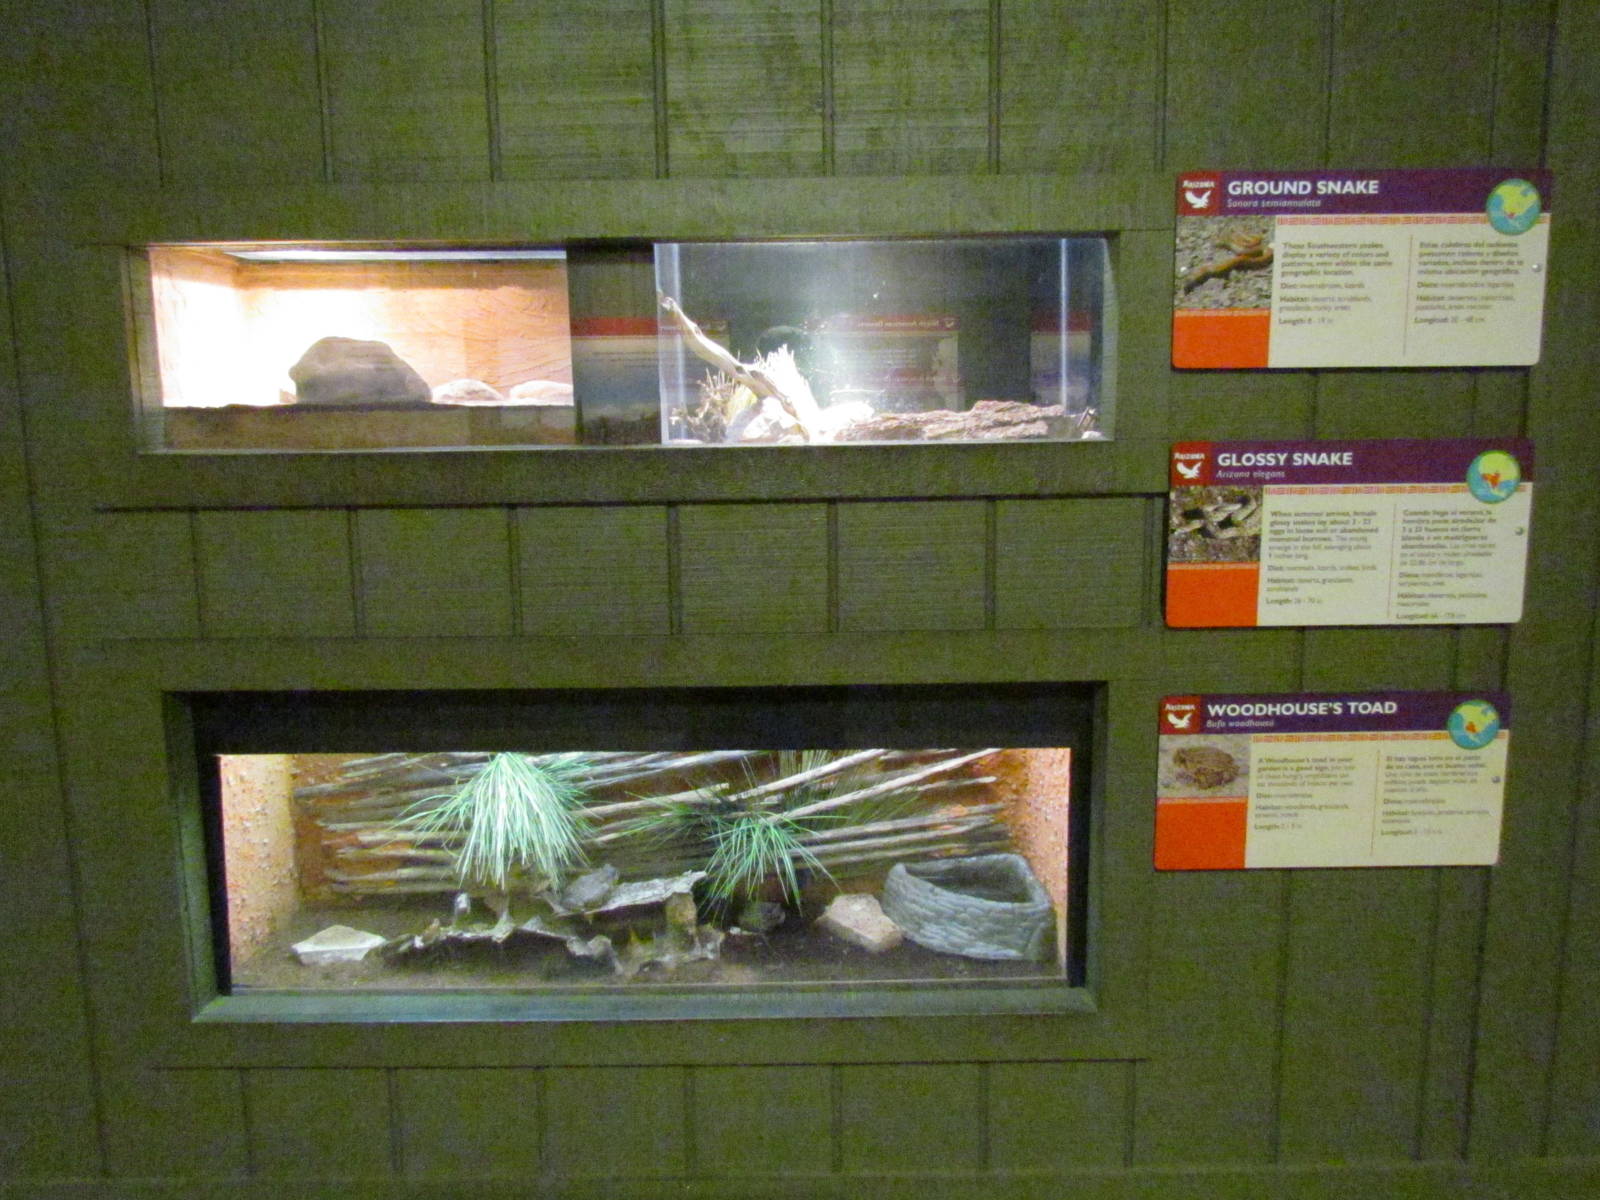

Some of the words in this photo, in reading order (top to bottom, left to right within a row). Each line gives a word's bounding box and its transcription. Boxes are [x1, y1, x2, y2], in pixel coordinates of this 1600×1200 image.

[1228, 180, 1311, 195] GROUND
[1316, 180, 1379, 194] SNAKE
[1217, 453, 1288, 466] GLOSSY
[1292, 452, 1353, 465] SNAKE
[1216, 470, 1250, 478] Arizona
[1252, 470, 1286, 479] elegans
[1207, 702, 1343, 717] WOODHOUSE'S
[1347, 702, 1398, 714] TOAD
